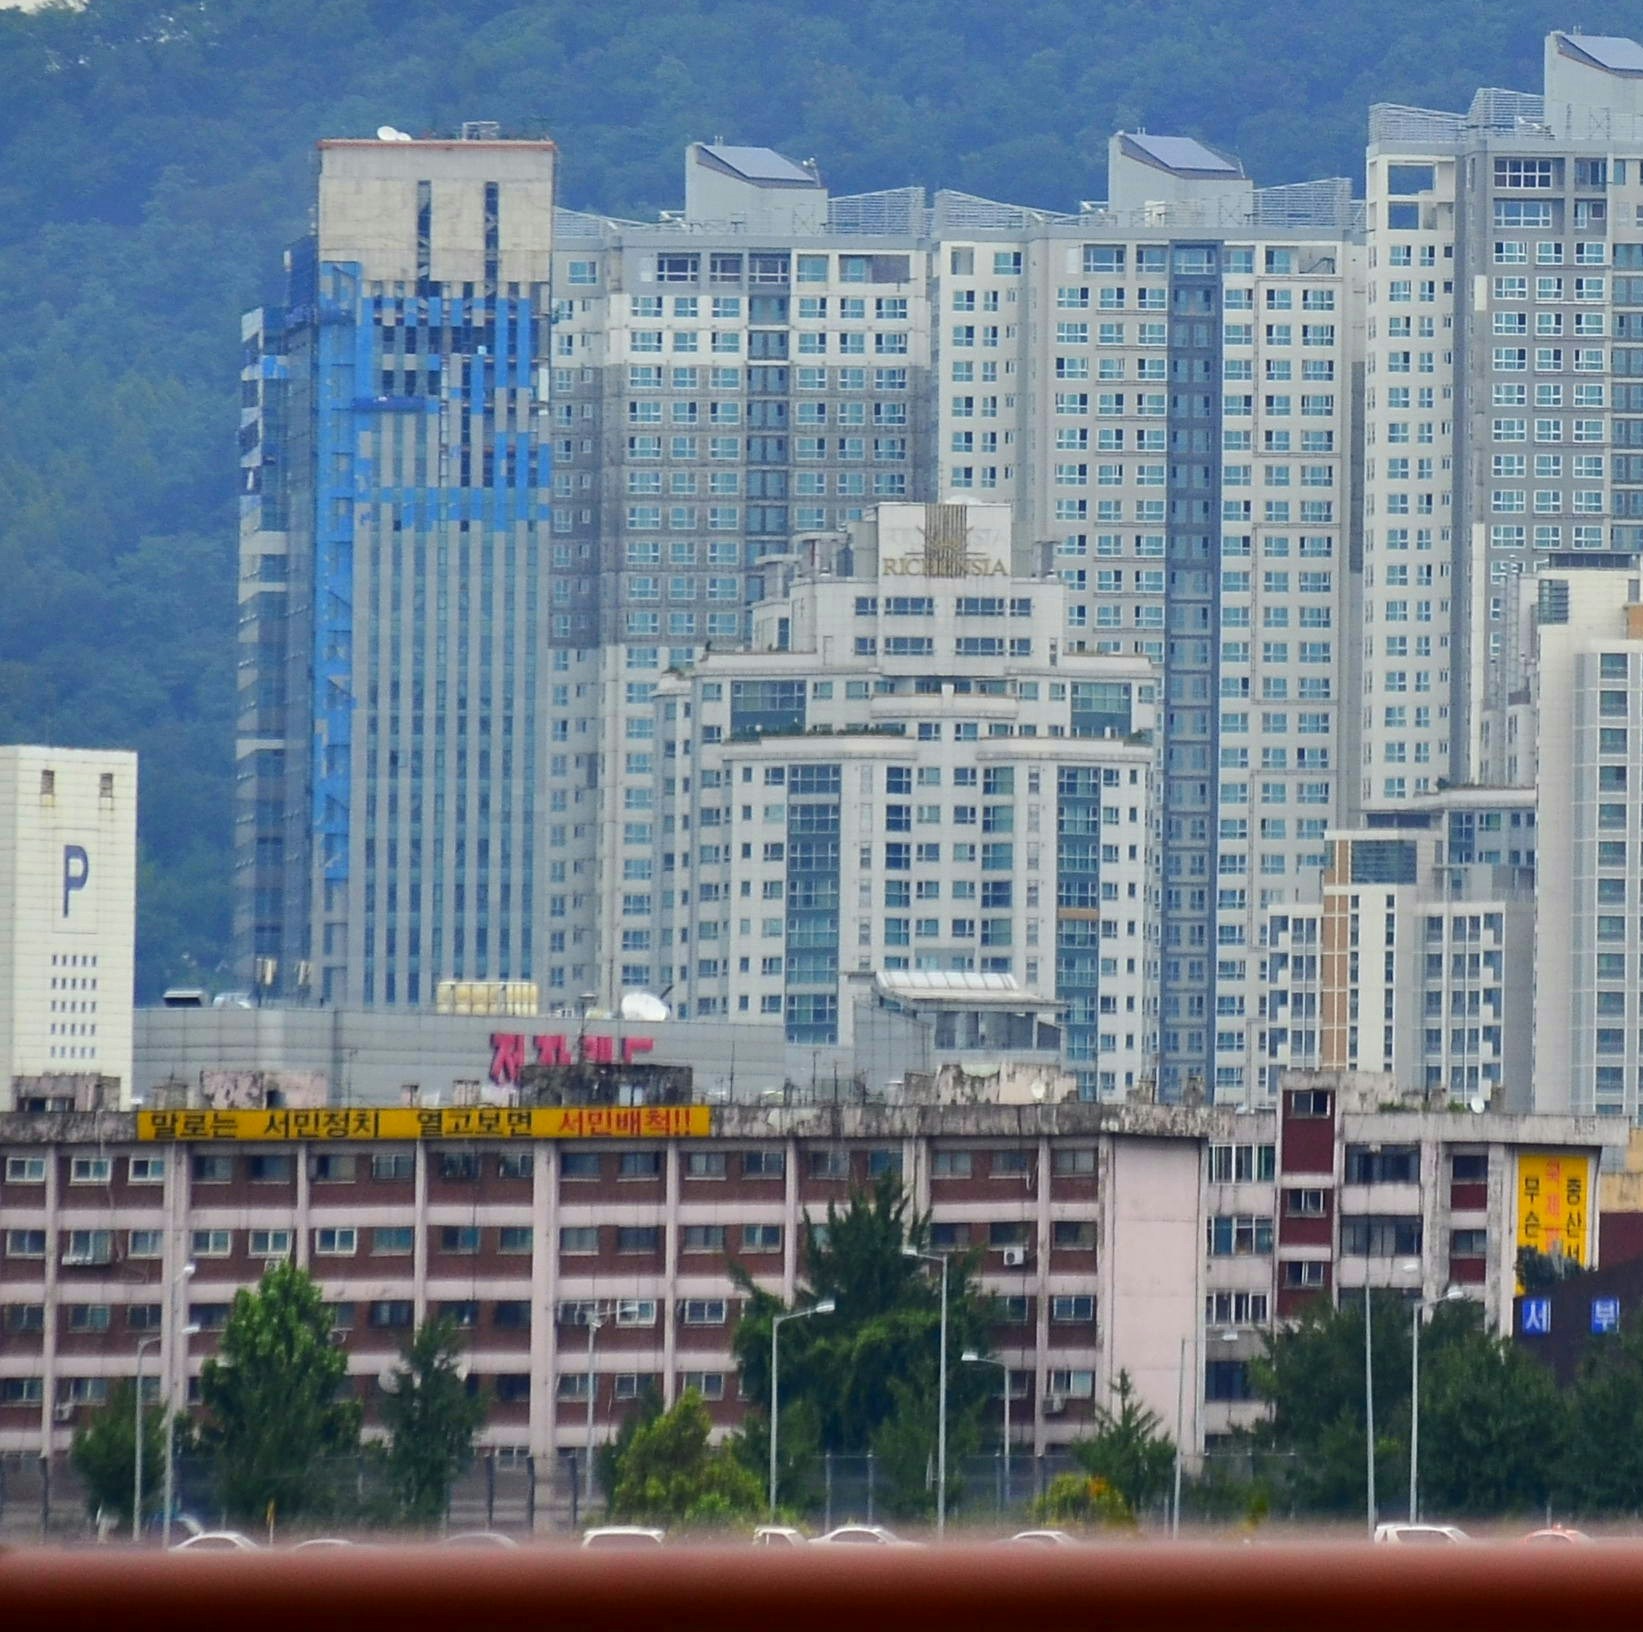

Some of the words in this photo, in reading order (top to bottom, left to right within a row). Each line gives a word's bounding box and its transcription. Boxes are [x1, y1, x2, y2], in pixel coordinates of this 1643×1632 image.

[63, 844, 89, 917] P
[151, 1113, 238, 1139] 말로는
[264, 1112, 380, 1139] 서민정치
